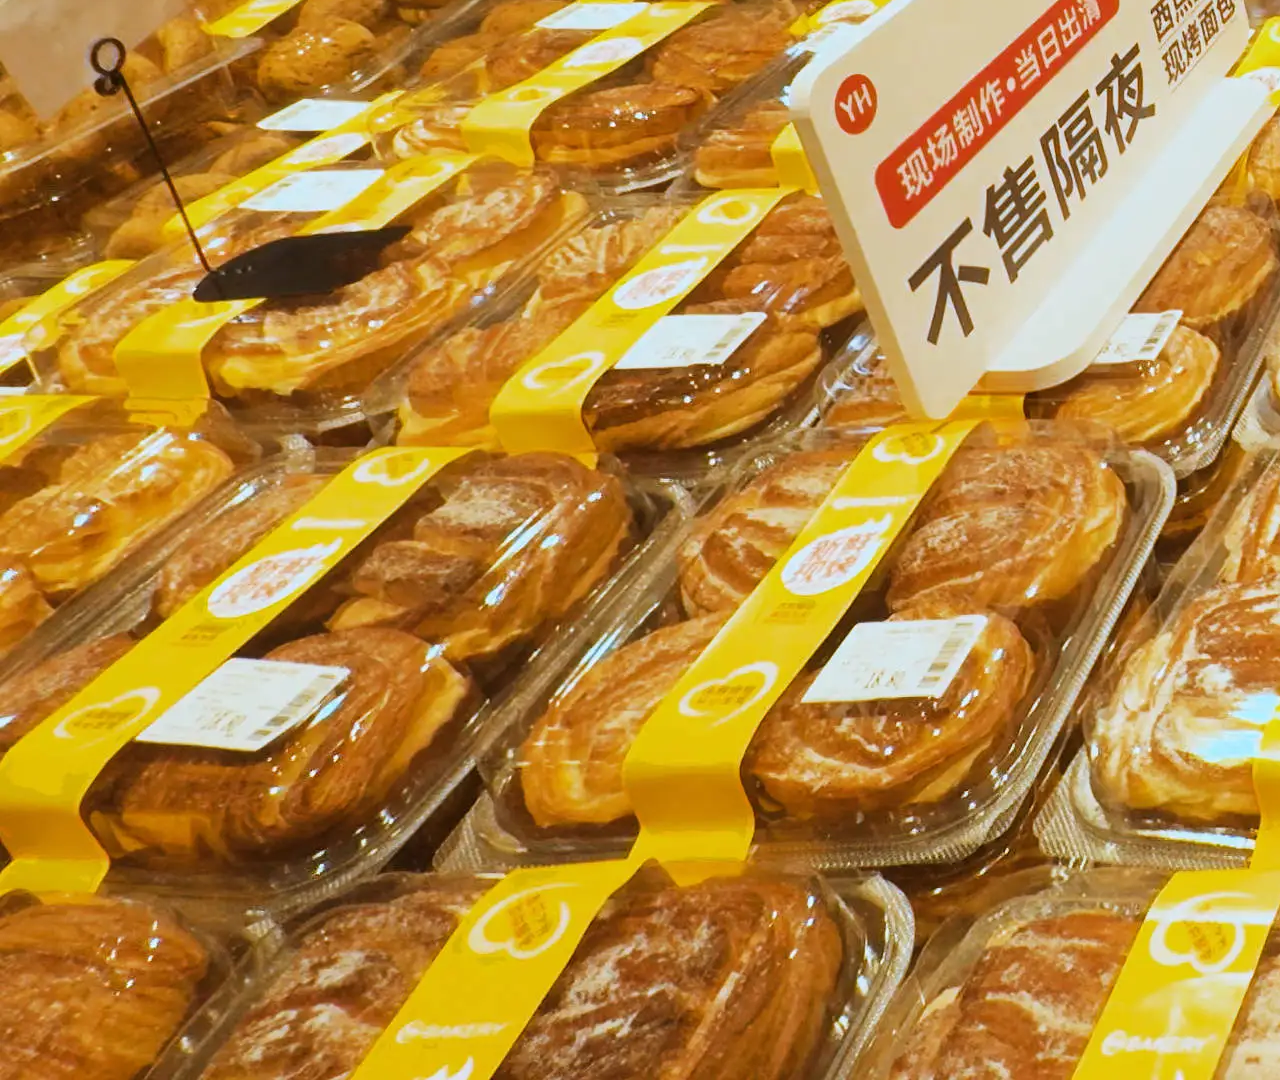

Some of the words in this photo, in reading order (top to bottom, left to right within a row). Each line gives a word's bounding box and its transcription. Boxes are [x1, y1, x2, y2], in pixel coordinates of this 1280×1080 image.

[839, 82, 873, 125] YH
[908, 42, 1158, 346] 不售隔夜
